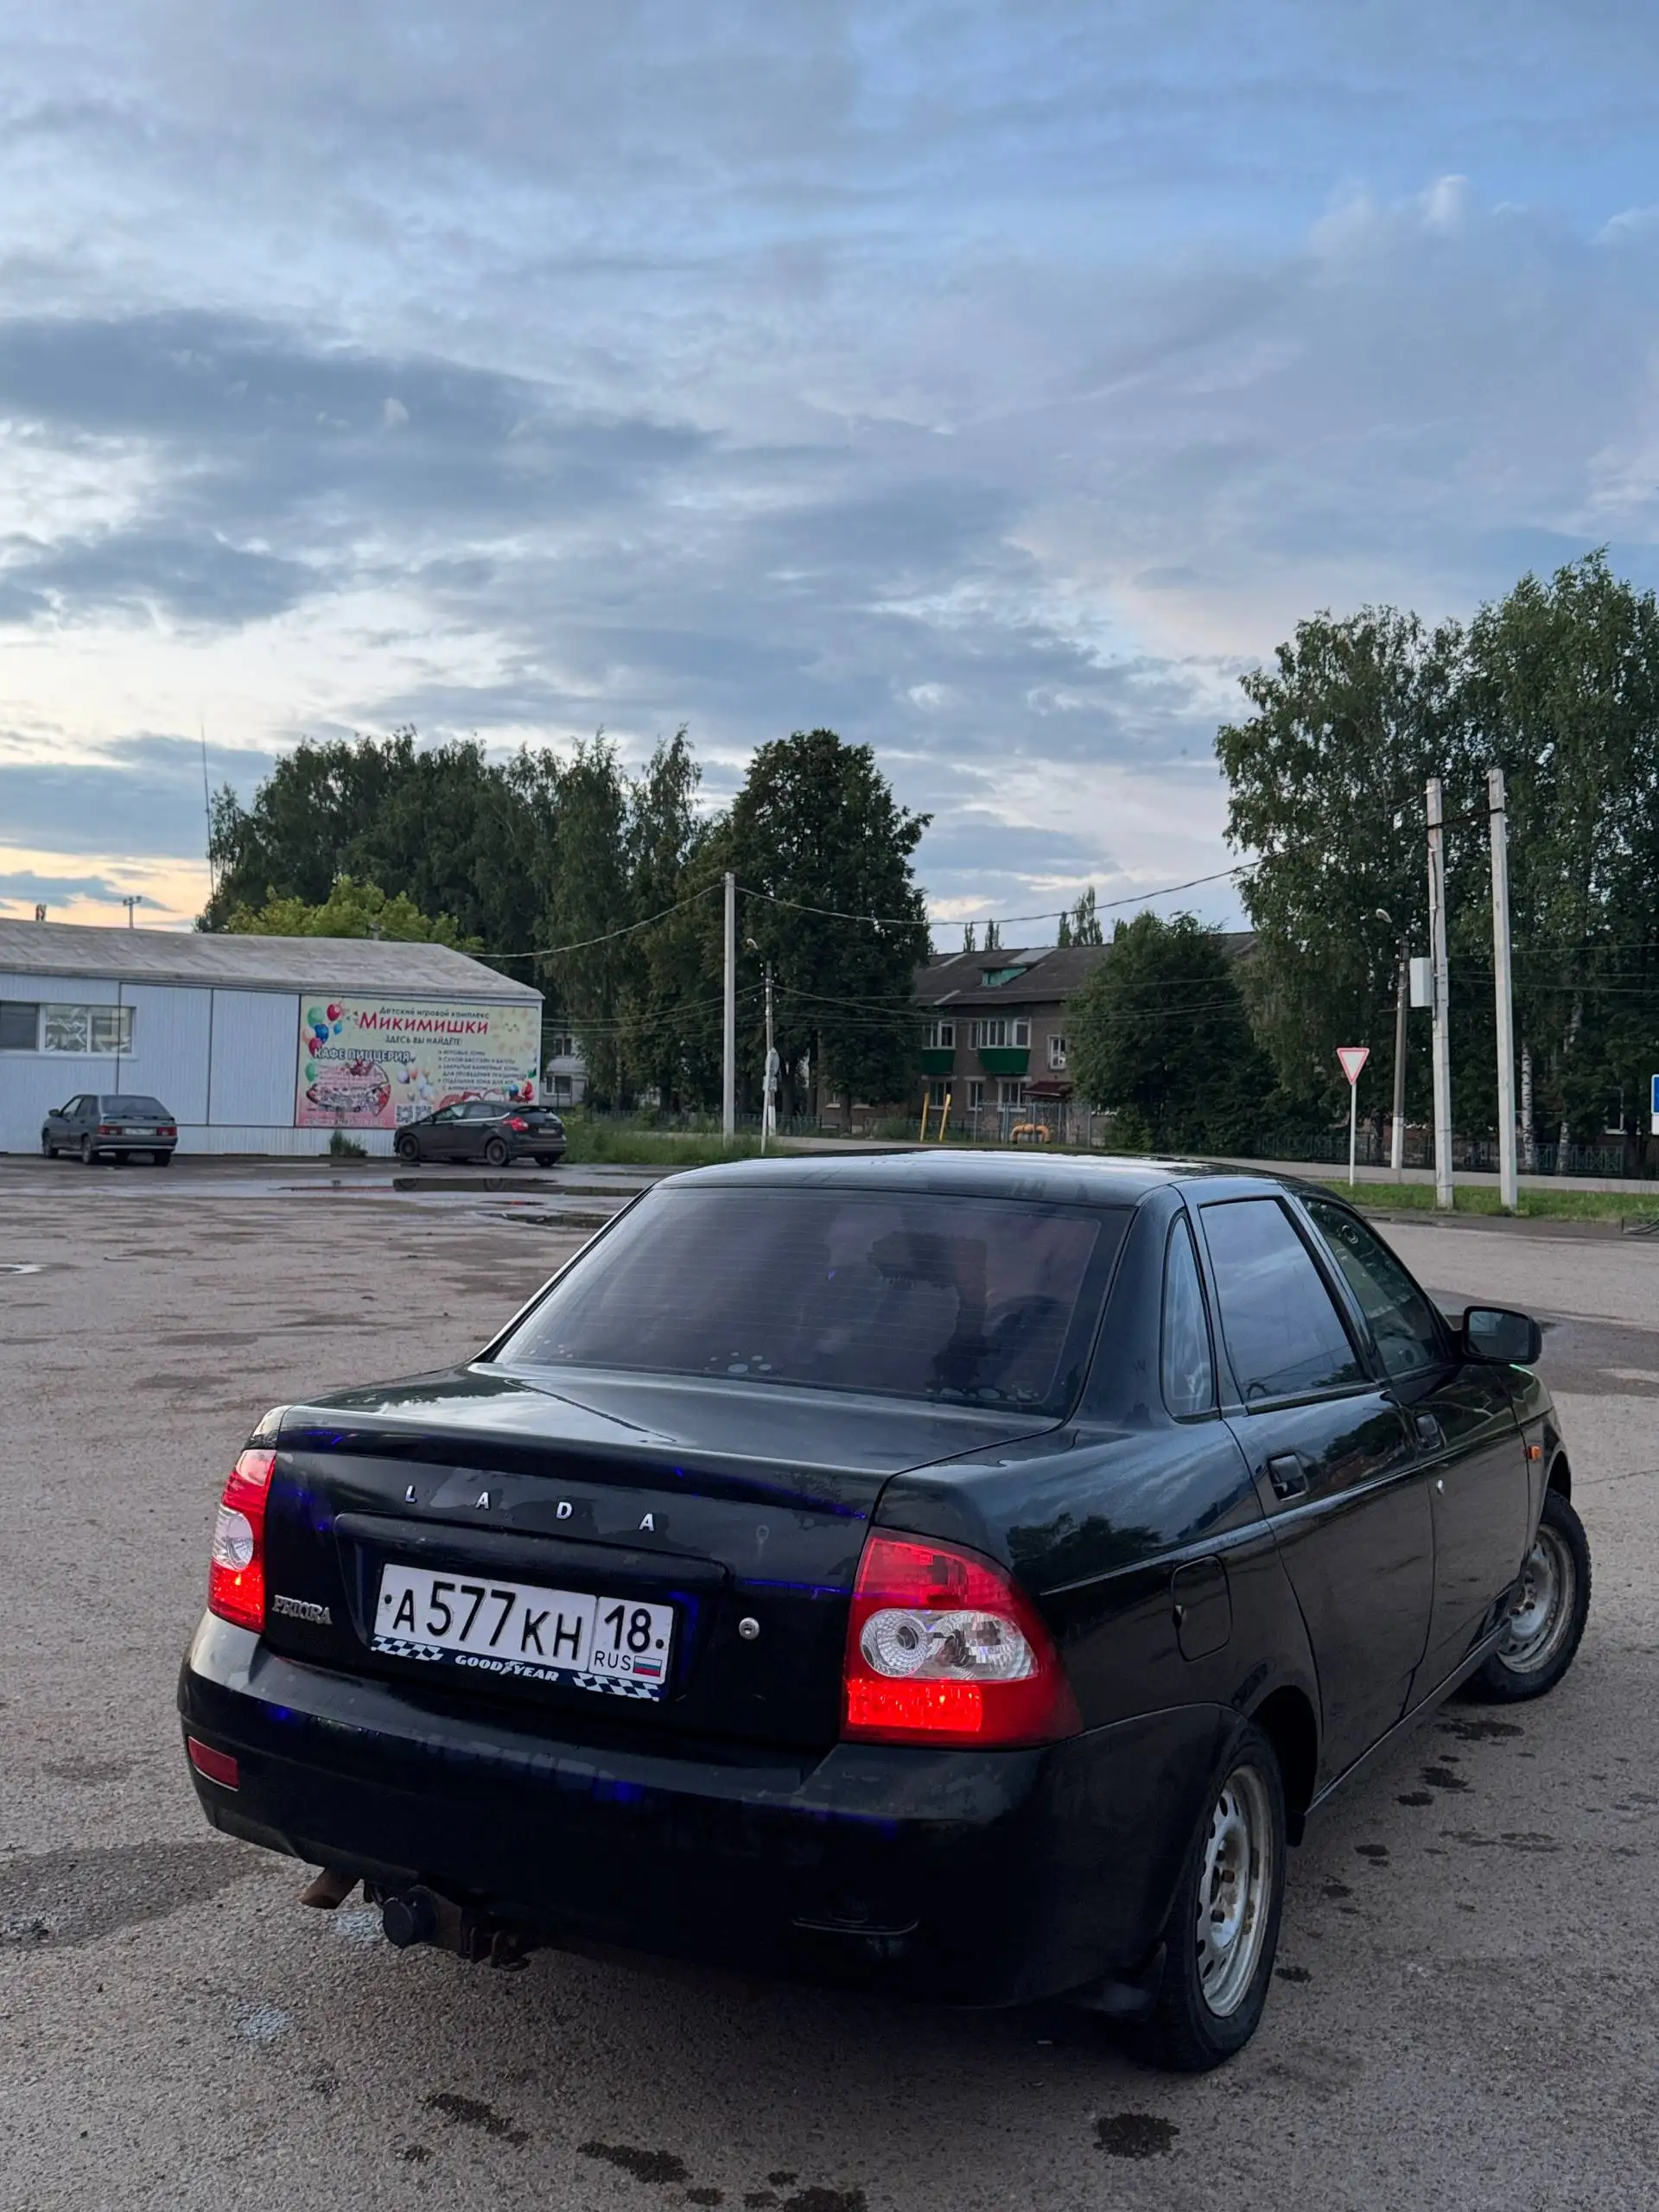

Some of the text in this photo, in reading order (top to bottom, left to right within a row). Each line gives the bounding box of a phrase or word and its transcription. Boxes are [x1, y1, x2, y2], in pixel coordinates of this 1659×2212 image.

[359, 1011, 489, 1035] Микимишки
[378, 1007, 489, 1020] Детский игровой комплекс
[385, 1035, 411, 1044] ЗДЕСЬ
[413, 1036, 424, 1045] ВЫ
[314, 1047, 411, 1064] КАФЕ ПИЦЦЕРИЯ
[405, 1485, 655, 1532] LADA
[271, 1594, 334, 1624] PRIORA
[604, 1605, 652, 1653] 18
[594, 1650, 632, 1671] RUS
